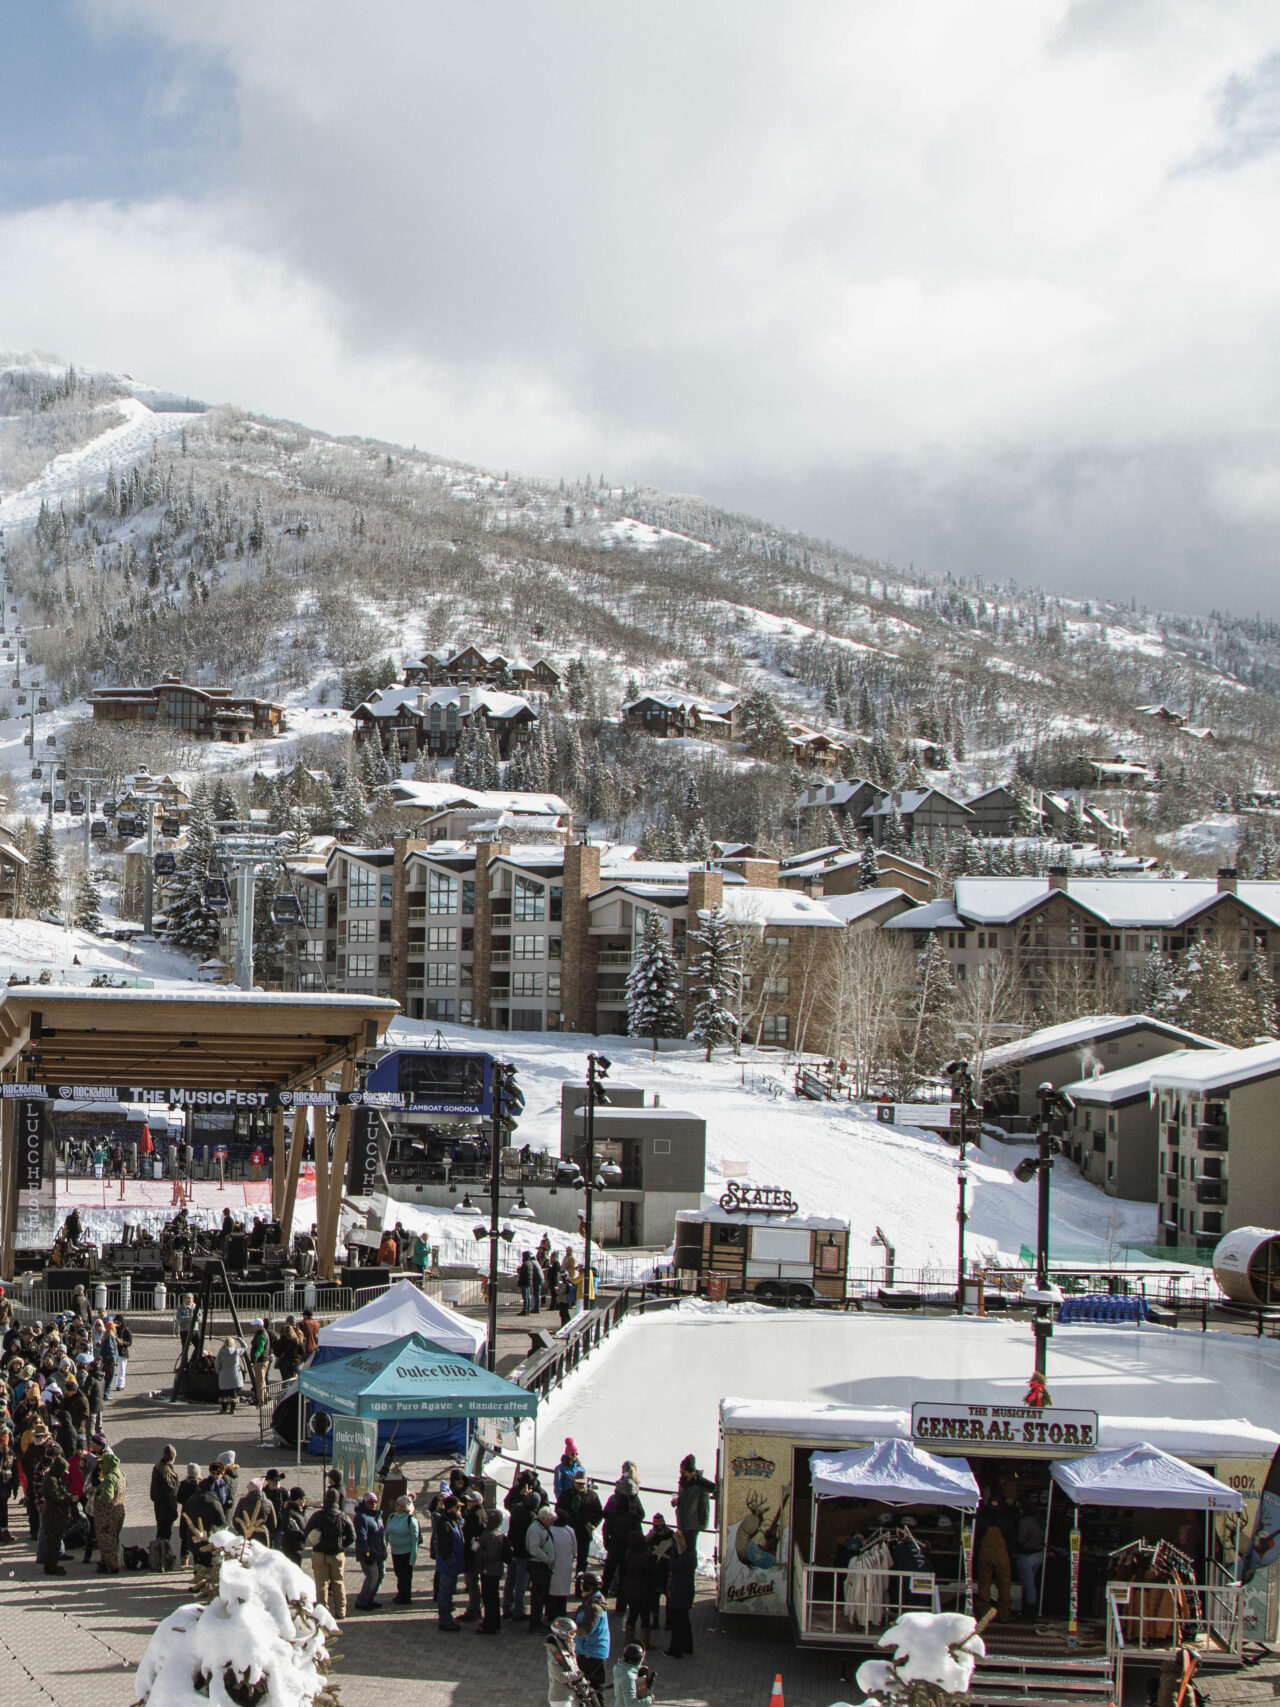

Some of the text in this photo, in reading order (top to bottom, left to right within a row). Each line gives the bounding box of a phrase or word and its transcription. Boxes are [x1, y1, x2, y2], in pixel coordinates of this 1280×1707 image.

[26, 1103, 40, 1228] LUCCHESE
[720, 1183, 793, 1211] SKATES
[469, 1401, 528, 1411] Handcrafted
[968, 1406, 1043, 1419] THE MUSICFEST
[916, 1417, 1093, 1445] GENERAL STORE
[1229, 1475, 1255, 1489] 100%
[727, 1580, 774, 1602] Get Real
